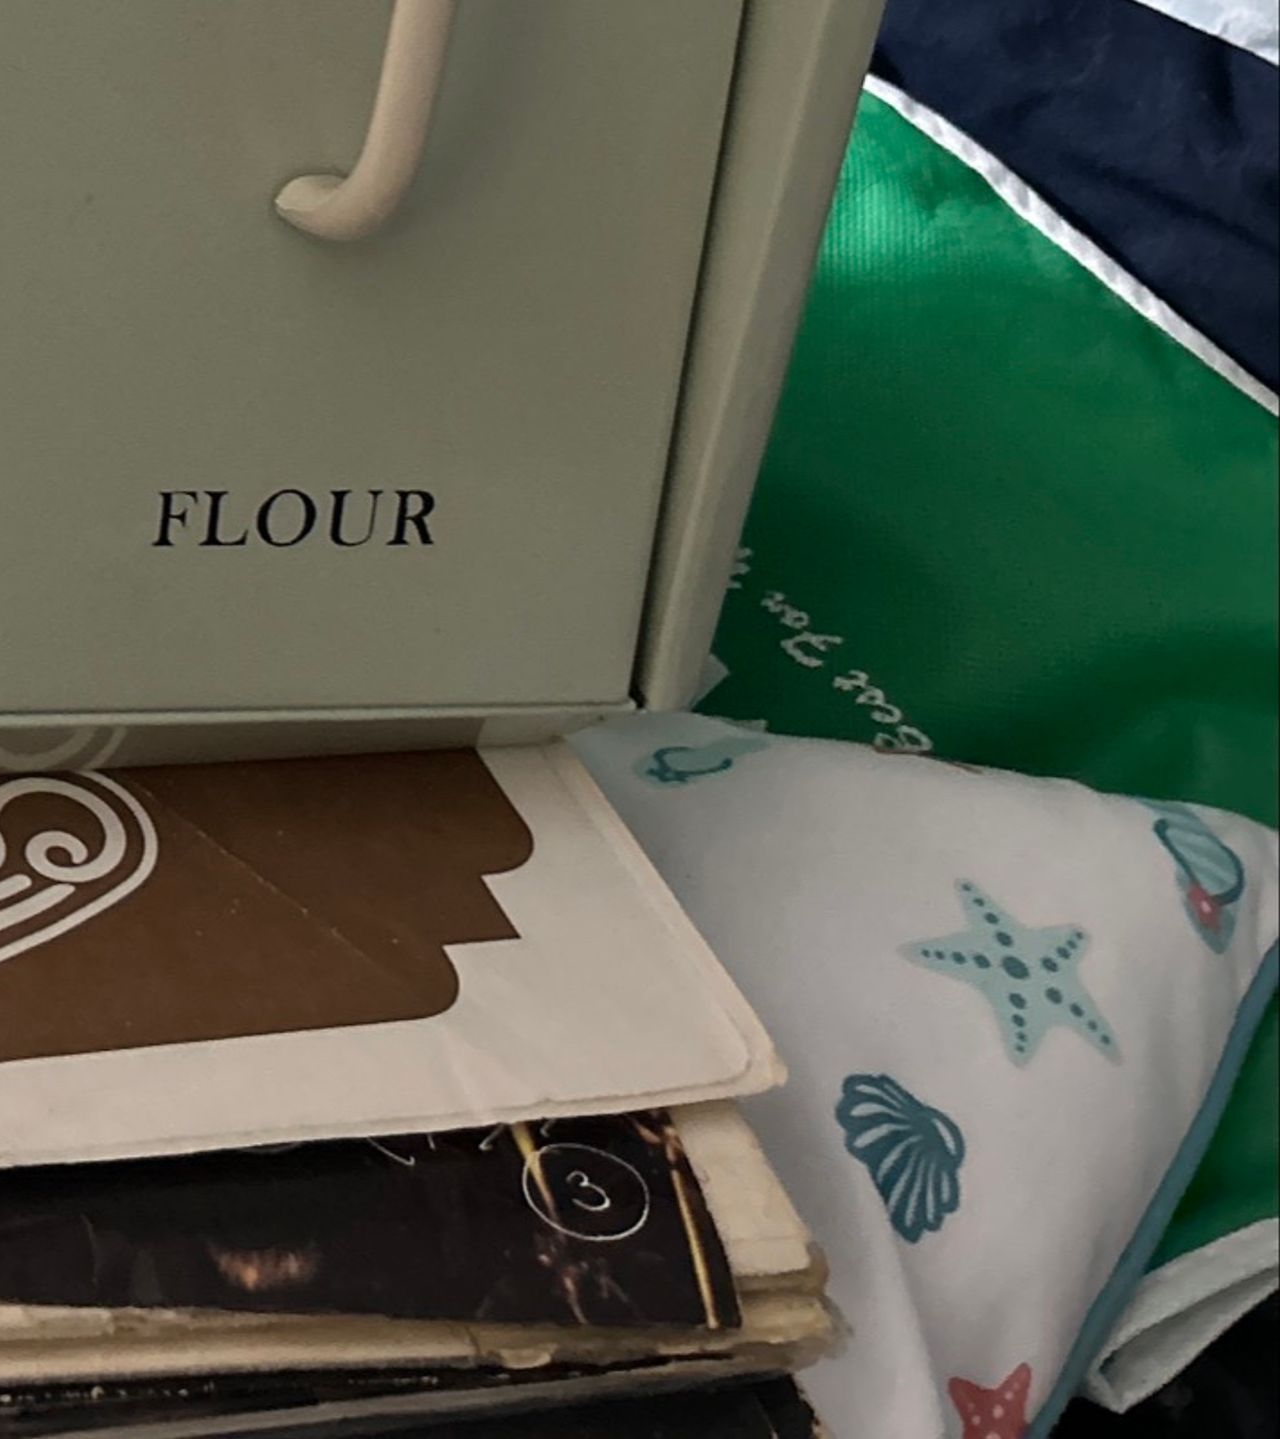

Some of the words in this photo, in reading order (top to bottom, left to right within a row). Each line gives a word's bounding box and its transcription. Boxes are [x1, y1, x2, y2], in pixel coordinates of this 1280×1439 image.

[152, 488, 435, 548] FLOUR
[760, 590, 844, 668] For
[832, 669, 934, 753] Best
[565, 1170, 611, 1213] 3
